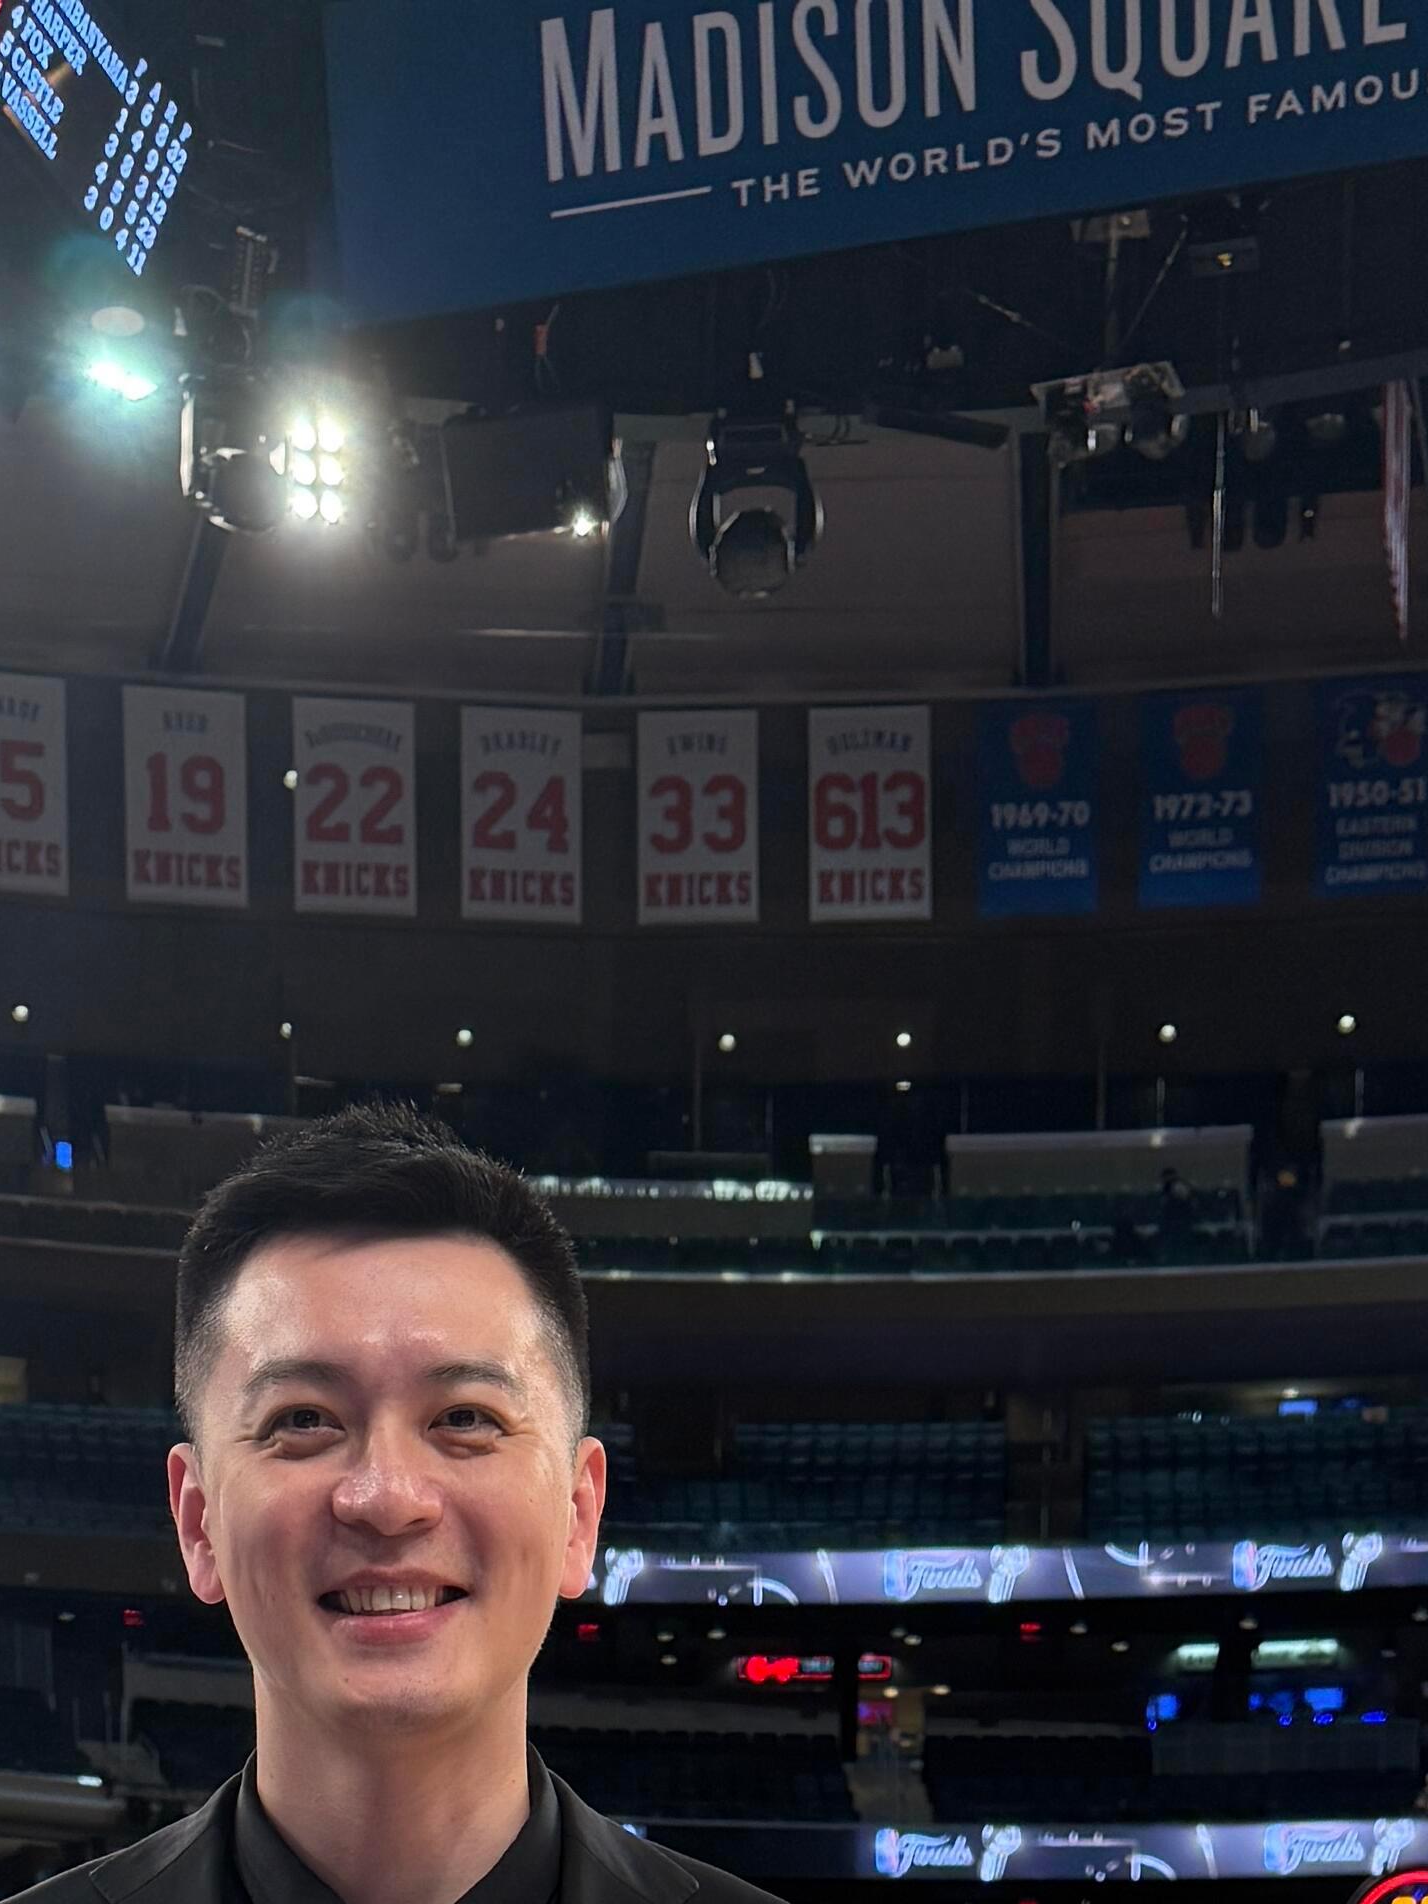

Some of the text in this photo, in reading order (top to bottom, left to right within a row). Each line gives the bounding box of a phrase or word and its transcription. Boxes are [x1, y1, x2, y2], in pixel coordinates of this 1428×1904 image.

[20, 16, 54, 70] FOX
[31, 0, 88, 76] HARPER
[11, 47, 65, 125] CASTLE
[540, 0, 978, 182] MADISON
[2, 71, 59, 161] VASSELL
[99, 205, 114, 231] 0
[731, 168, 821, 206] THE
[843, 127, 1062, 188] WORLD'S
[1086, 100, 1222, 150] MOST
[147, 752, 226, 835] 19
[305, 762, 404, 845] 22
[472, 770, 570, 855] 24
[648, 773, 748, 856] 33
[813, 770, 926, 851] 613
[990, 800, 1091, 830] 1969-70
[1152, 790, 1254, 821] 1972-73
[134, 849, 242, 890] KNICKS
[301, 859, 411, 899] KNICKS
[469, 866, 575, 908] KNICKS
[644, 871, 752, 908] KNICKS
[817, 867, 925, 905] KNICKS
[900, 1556, 983, 1602] Finals
[1251, 1543, 1335, 1591] Finals
[891, 1833, 974, 1879] Finals
[1278, 1828, 1366, 1875] Finals
